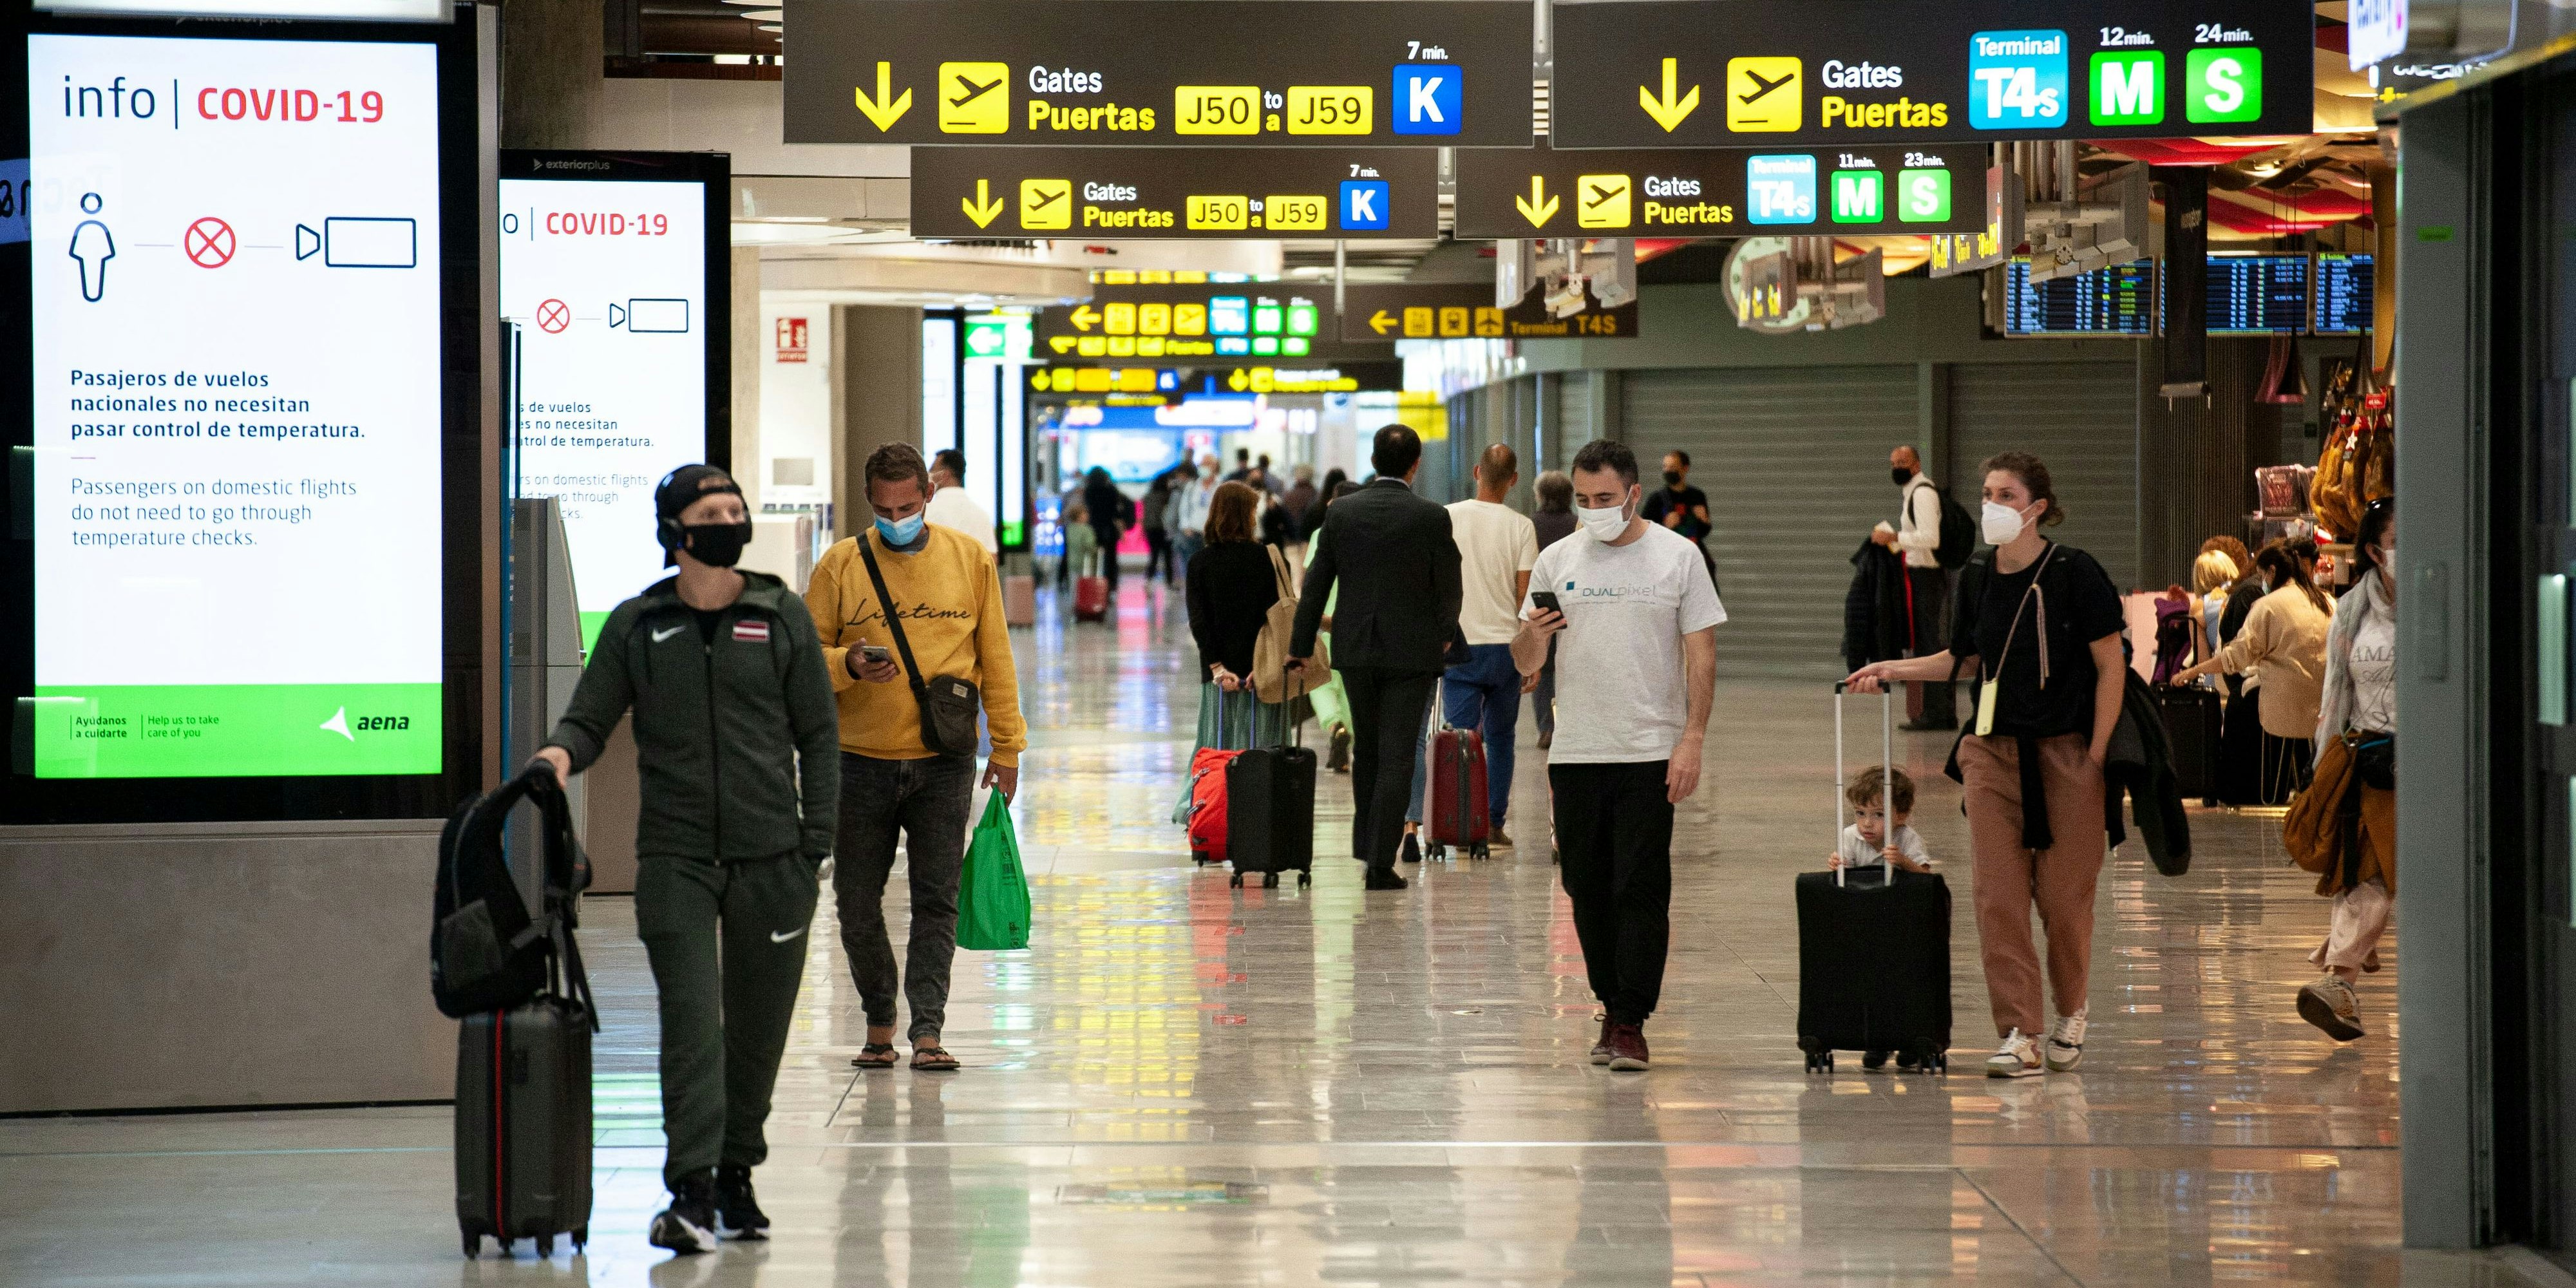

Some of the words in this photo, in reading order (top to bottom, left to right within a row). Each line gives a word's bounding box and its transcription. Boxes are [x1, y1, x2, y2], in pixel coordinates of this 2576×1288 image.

[1407, 41, 1421, 60] 7
[1422, 45, 1449, 60] min.
[1975, 35, 2061, 57] Terminal
[1028, 65, 1103, 93] Gates
[1822, 59, 1903, 89] Gates
[2100, 61, 2154, 116] M
[2204, 57, 2244, 113] S
[64, 75, 155, 119] info
[198, 87, 383, 123] COVID-19
[1264, 90, 1283, 109] to
[1409, 77, 1444, 122] K
[1028, 100, 1155, 131] Puertas
[1186, 97, 1249, 125] J50
[1299, 97, 1361, 125] J59
[1822, 96, 1948, 128] Puertas
[1265, 113, 1280, 131] a
[546, 160, 611, 171] exteriorplus
[1350, 164, 1360, 178] 7
[1360, 167, 1380, 177] min.
[1752, 158, 1812, 175] Terminal
[1083, 182, 1137, 201] Gates
[1644, 176, 1701, 197] Gates
[1911, 176, 1938, 216] S
[1249, 199, 1264, 212] to
[1351, 189, 1377, 222] K
[1837, 177, 1877, 217] M
[1083, 205, 1174, 228] Puertas
[1195, 203, 1239, 223] J50
[1250, 214, 1262, 227] a
[1274, 203, 1318, 223] J59
[1644, 201, 1734, 224] Puertas
[546, 212, 668, 236] COVID-19
[1576, 314, 1616, 336] T4S
[71, 370, 167, 390] Pasajeros
[174, 370, 197, 386] de
[204, 371, 269, 387] vuelos
[71, 395, 176, 412] nacionales
[184, 399, 207, 412] no
[215, 396, 309, 412] necesitan
[529, 401, 544, 413] de
[549, 401, 591, 413] vuelos
[71, 424, 126, 440] pasar
[133, 421, 200, 437] control
[207, 421, 231, 437] de
[238, 423, 365, 441] temperatura.
[536, 421, 551, 430] no
[556, 419, 618, 430] necesitan
[520, 435, 546, 446] trol
[551, 435, 566, 446] de
[571, 437, 654, 449] temperatura.
[72, 478, 176, 498] Passengers
[184, 482, 205, 495] on
[212, 478, 292, 495] domestic
[301, 478, 356, 499] flights
[535, 476, 549, 486] on
[553, 474, 607, 486] domestic
[611, 473, 649, 488] flights
[572, 491, 618, 505] through
[71, 504, 93, 520] do
[100, 506, 129, 520] not
[137, 504, 181, 520] need
[189, 506, 205, 520] to
[213, 507, 234, 524] go
[242, 504, 311, 524] through
[72, 531, 185, 549] temperature
[192, 529, 257, 545] checks.
[147, 715, 169, 726] Help
[172, 717, 184, 725] us
[198, 715, 220, 724] take
[357, 716, 410, 731] aena
[76, 730, 82, 738] a
[84, 728, 127, 738] cuidarte
[147, 729, 167, 738] care
[170, 727, 180, 737] of
[183, 729, 201, 739] you
